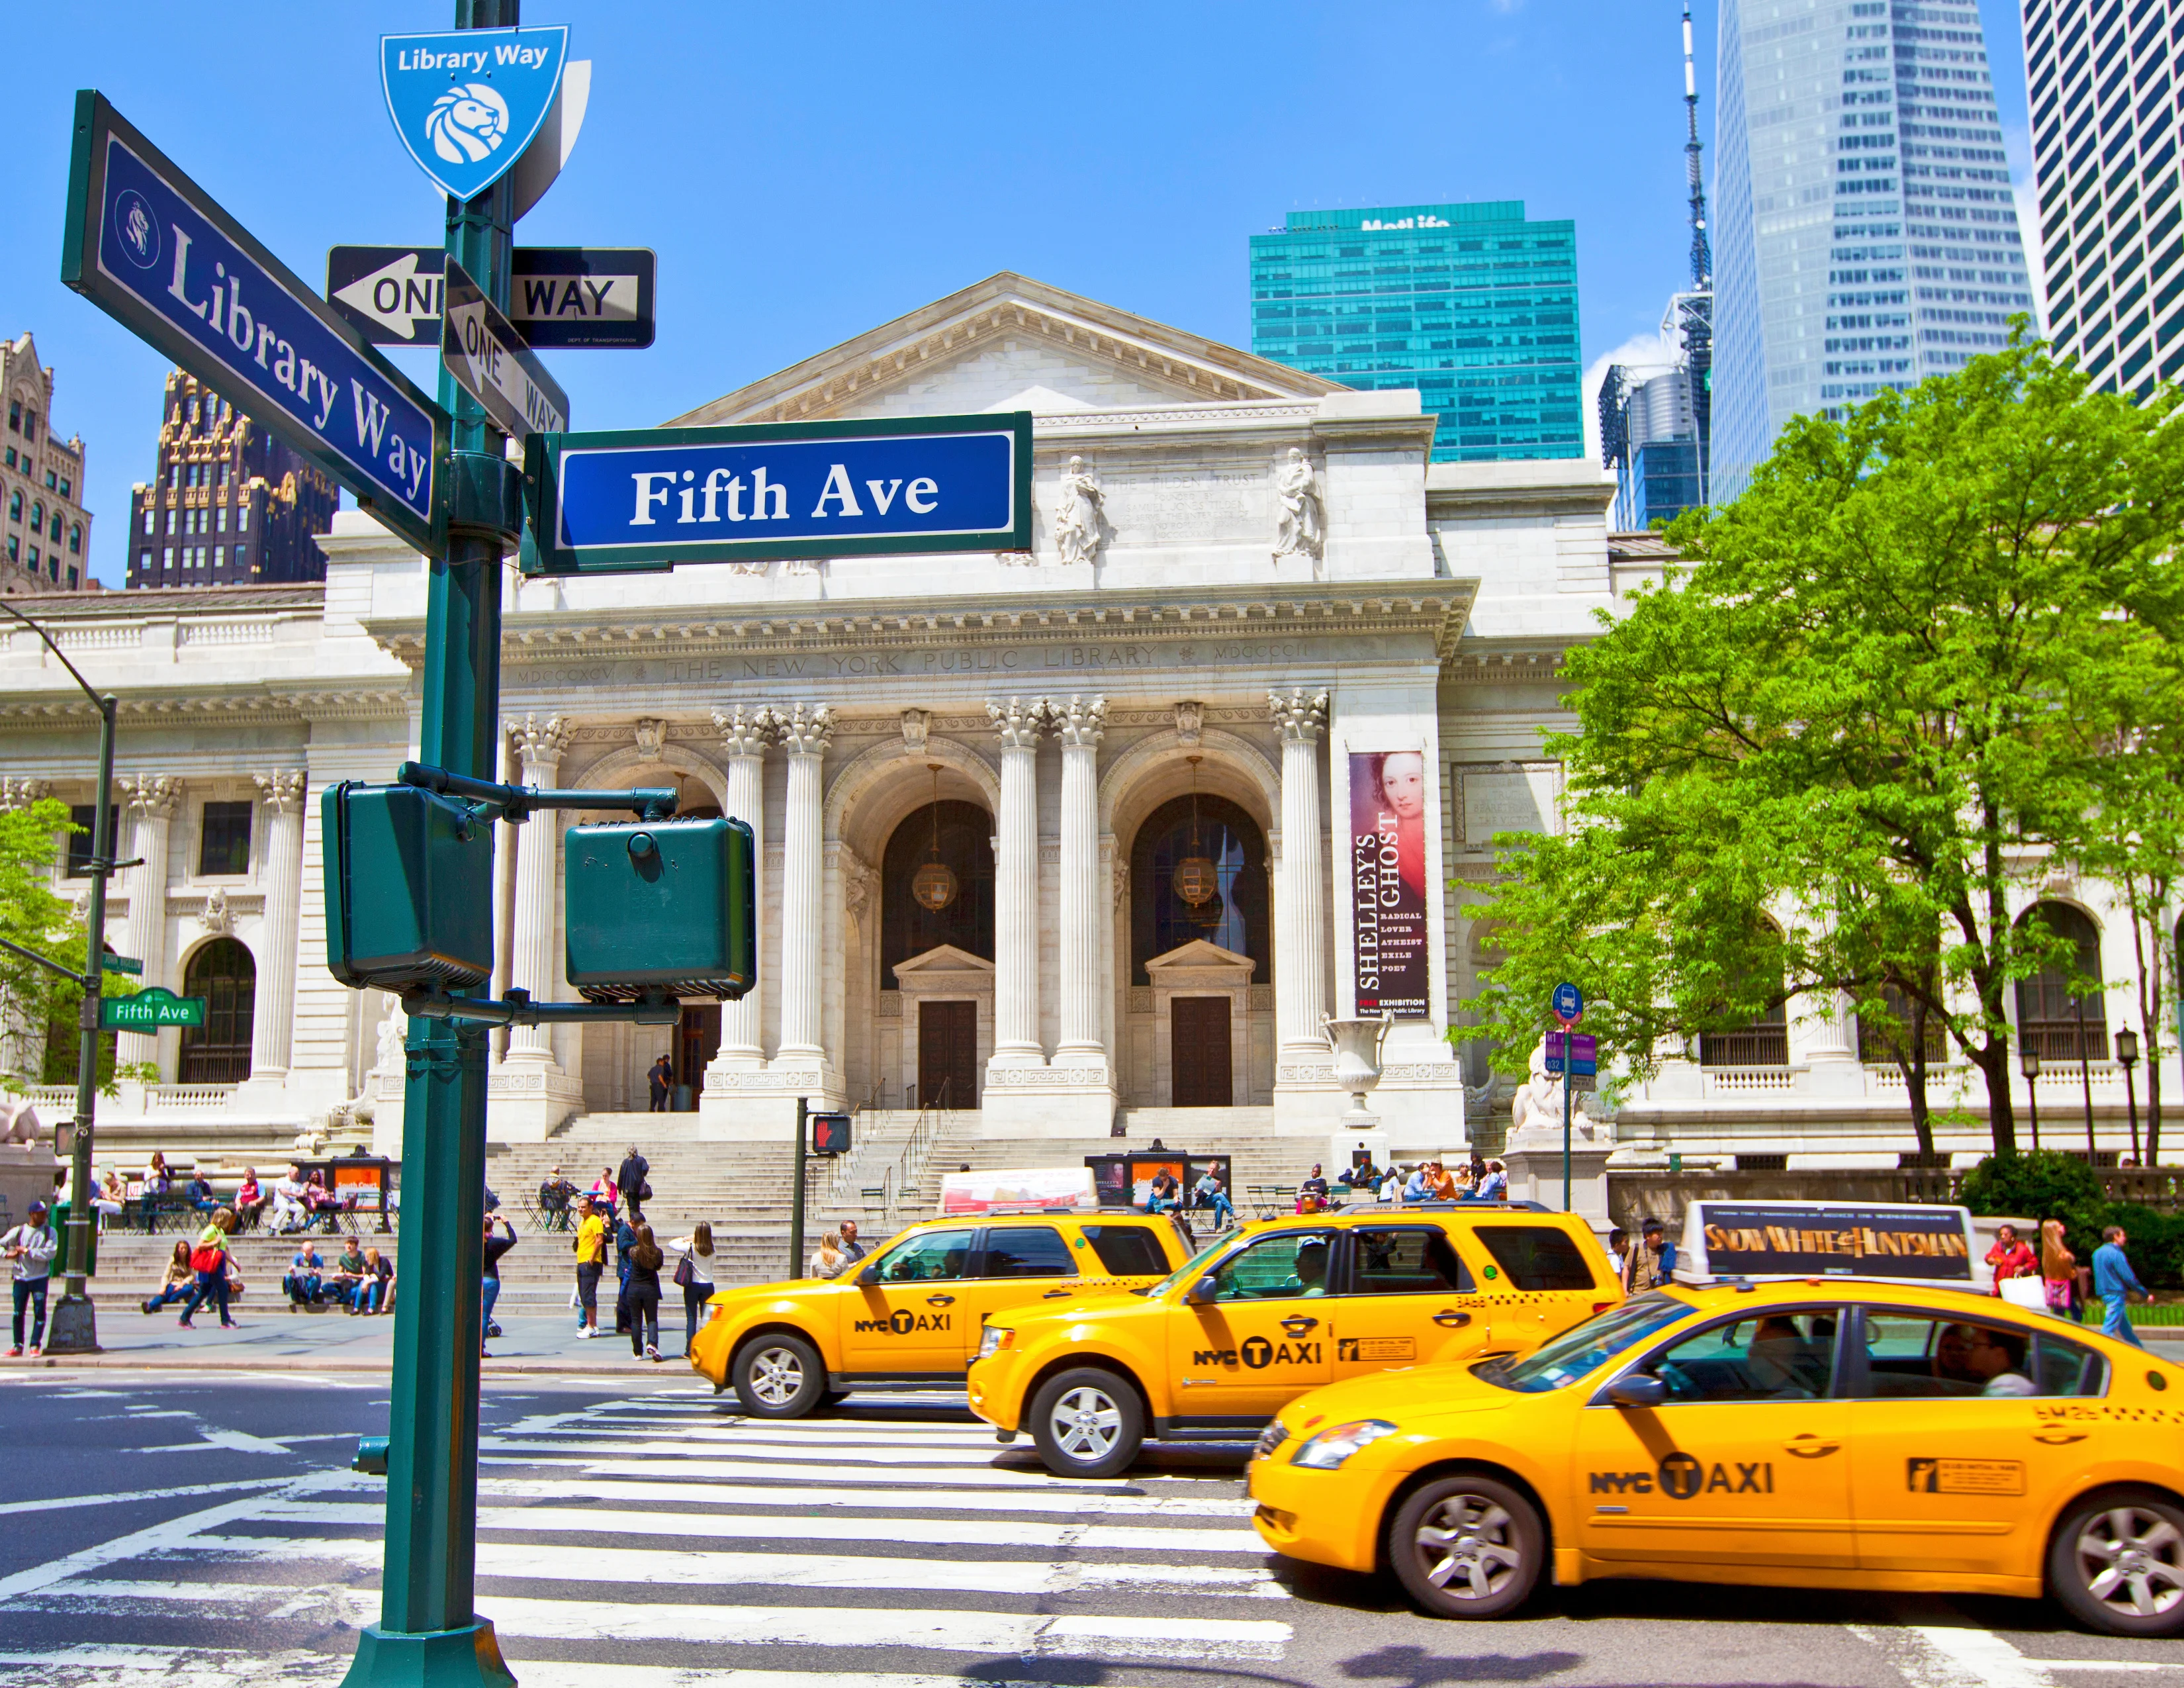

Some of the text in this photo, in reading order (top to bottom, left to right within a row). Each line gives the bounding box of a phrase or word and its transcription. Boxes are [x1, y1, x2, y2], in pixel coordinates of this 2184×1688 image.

[398, 44, 549, 74] Library Way
[524, 279, 615, 317] WAY
[167, 223, 427, 501] Library Way
[466, 314, 557, 432] ONE WAY
[629, 463, 938, 526] Fifth Ave
[1109, 474, 1259, 492] THE TILDEN TRUST
[518, 644, 1307, 683] MDCCCXCV THE NEW YORK PUBLIC LIBRARY MDCCCCII
[1378, 812, 1400, 908] GHOST
[1356, 833, 1379, 990] SHELLEY'S
[116, 1004, 189, 1019] Fifth Ave
[1547, 1033, 1556, 1043] M1
[1851, 1227, 1969, 1258] HUNTSMAN
[854, 1310, 951, 1334] NYC TAXI
[1193, 1336, 1322, 1368] NYC TAXI
[1589, 1452, 1774, 1499] NYC TAXI
